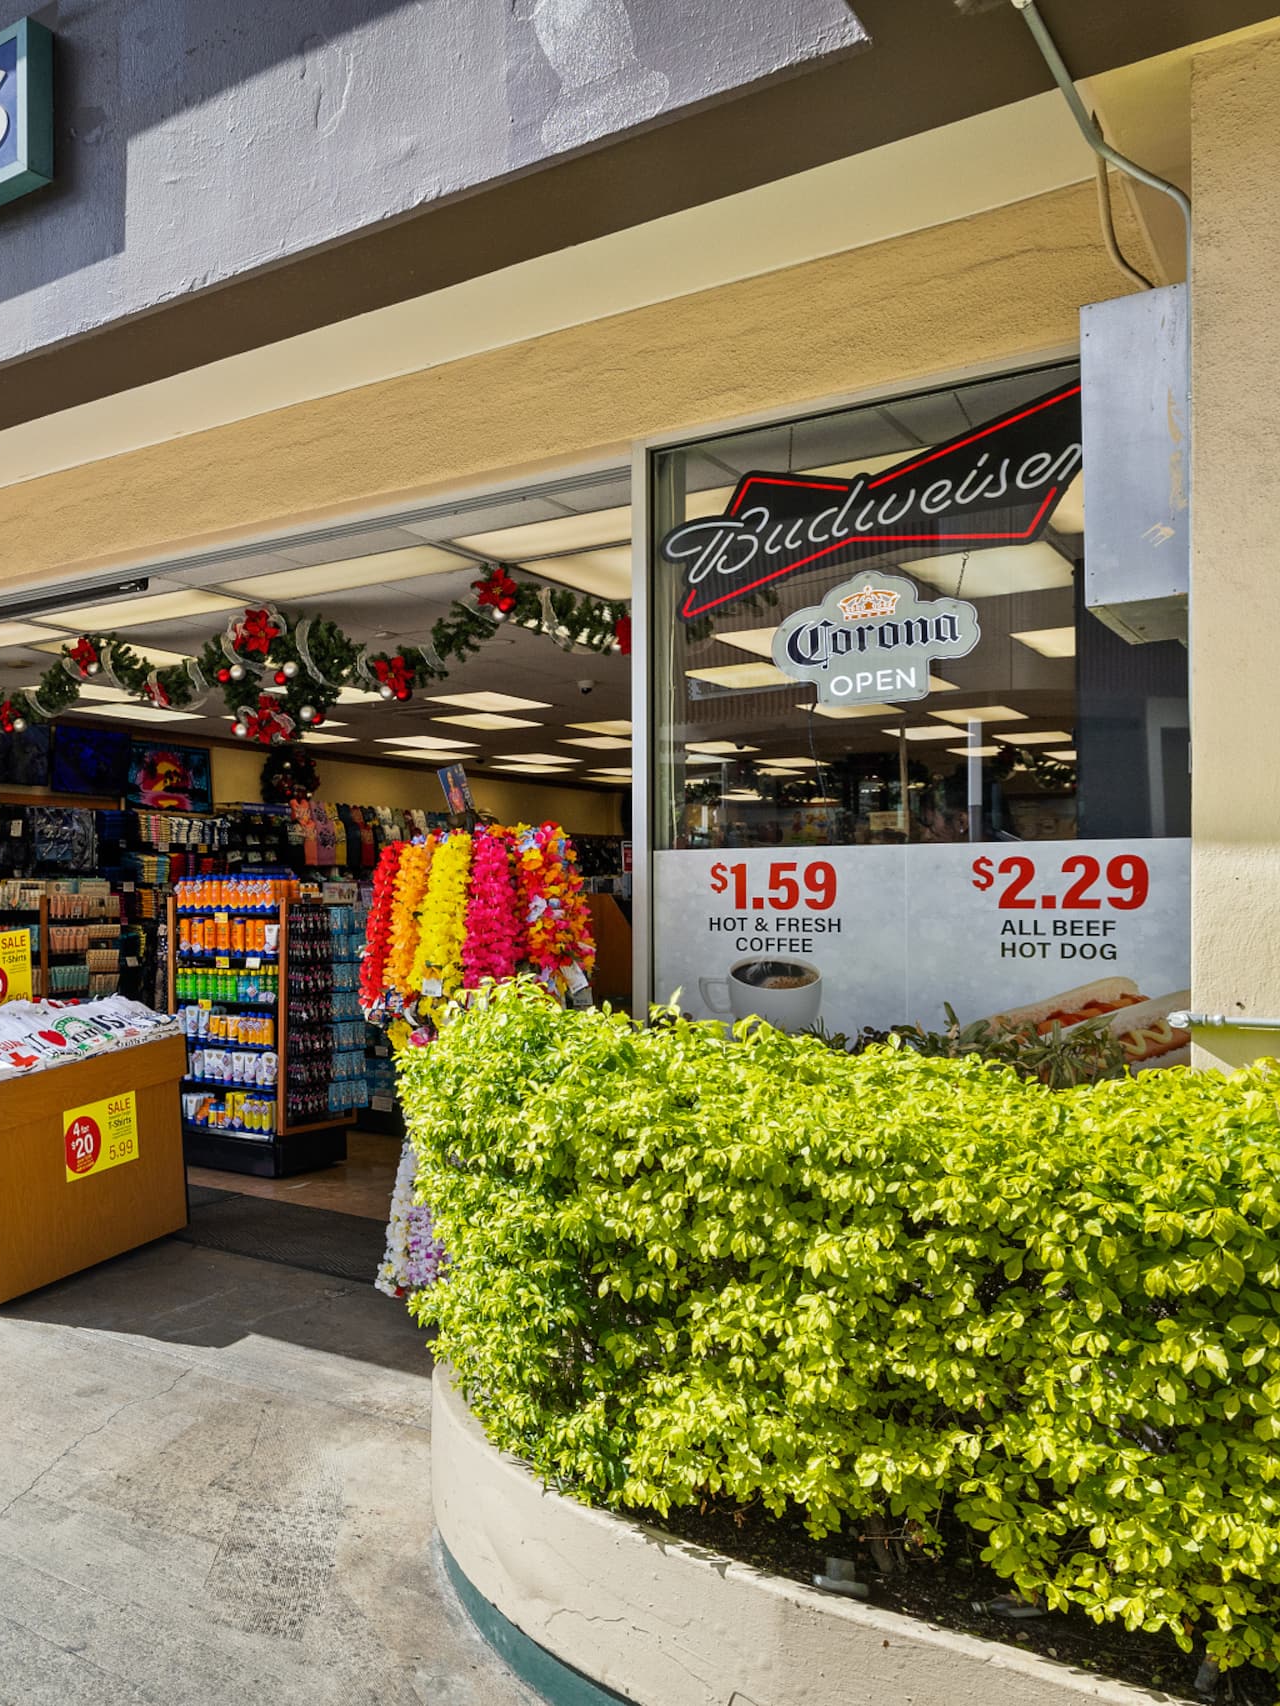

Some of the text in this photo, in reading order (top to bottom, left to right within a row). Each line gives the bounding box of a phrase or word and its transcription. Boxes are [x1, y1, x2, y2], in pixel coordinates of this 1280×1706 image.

[666, 443, 1082, 584] Budweiser
[786, 612, 962, 670] Corona
[830, 667, 916, 696] OPEN
[710, 861, 837, 911] $1.59
[972, 854, 1149, 911] $2.29
[709, 917, 842, 933] HOT & FRESH
[1000, 919, 1117, 937] ALL BEEF
[1, 935, 27, 949] SALE
[735, 937, 813, 952] COFFEE
[1001, 942, 1117, 960] HOT DOG
[2, 954, 27, 965] T-Shirts
[108, 1097, 131, 1115] SALE
[73, 1122, 80, 1137] 4
[108, 1117, 132, 1130] T-Shirts
[71, 1134, 94, 1159] $20
[109, 1139, 133, 1160] 5.99
